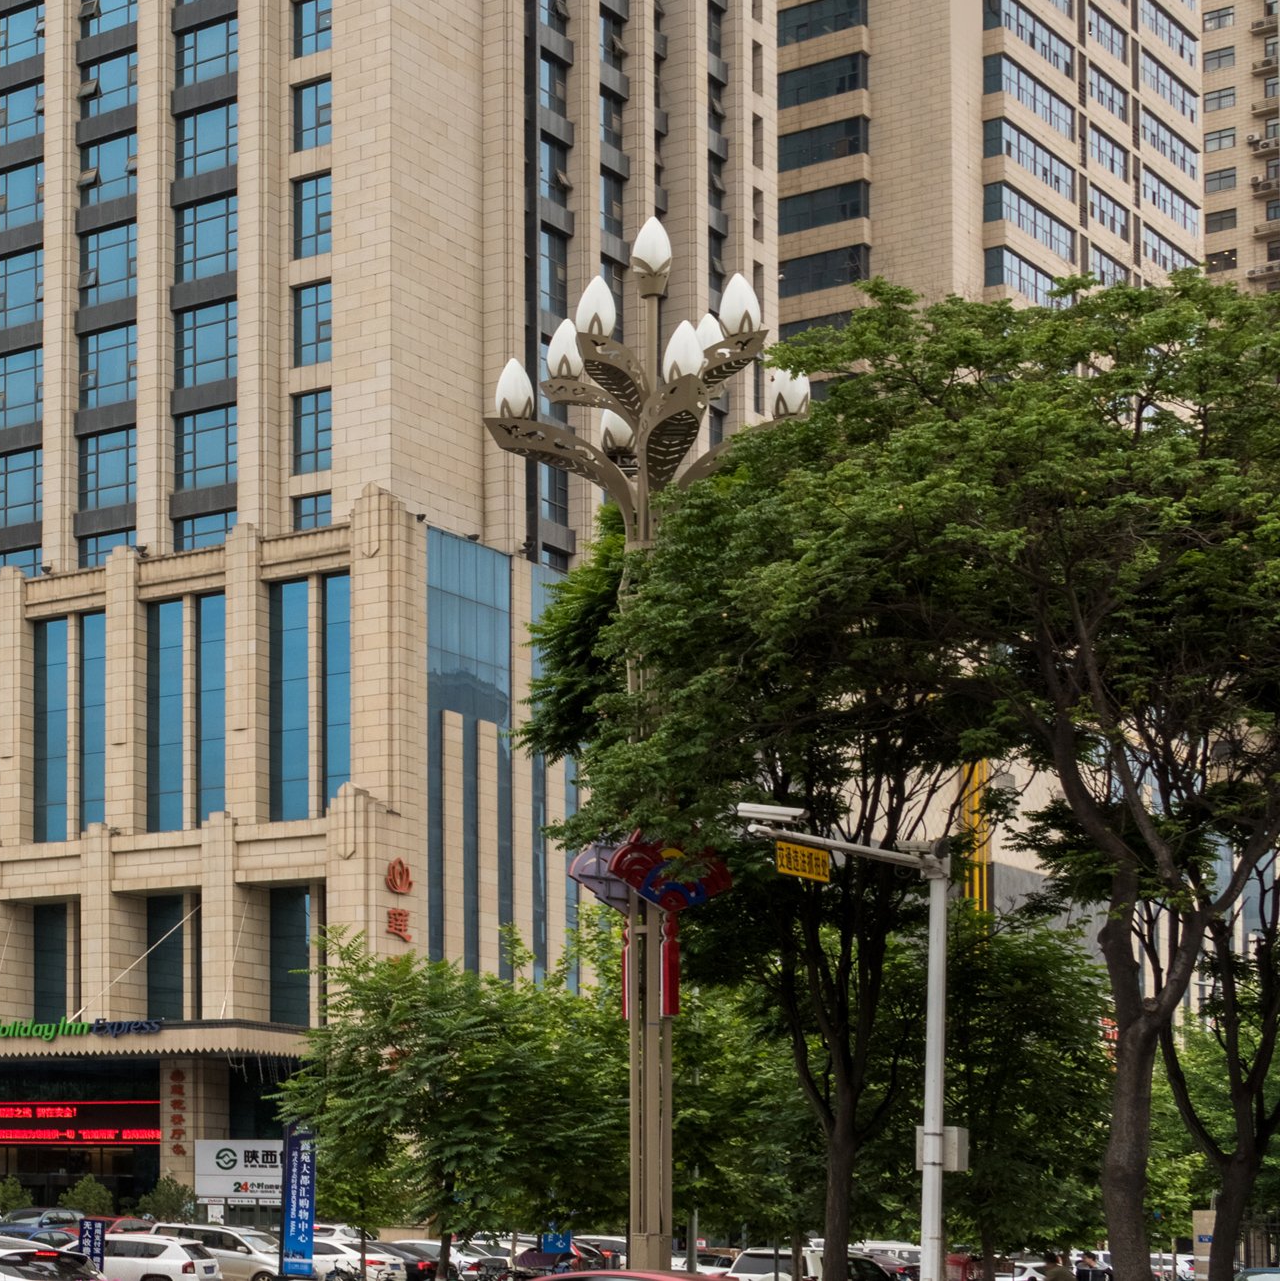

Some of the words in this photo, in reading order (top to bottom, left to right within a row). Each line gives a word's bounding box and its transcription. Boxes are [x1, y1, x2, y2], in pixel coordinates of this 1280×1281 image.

[58, 1016, 90, 1037] Inn
[91, 1018, 162, 1038] Express
[243, 1149, 284, 1164] 陕西
